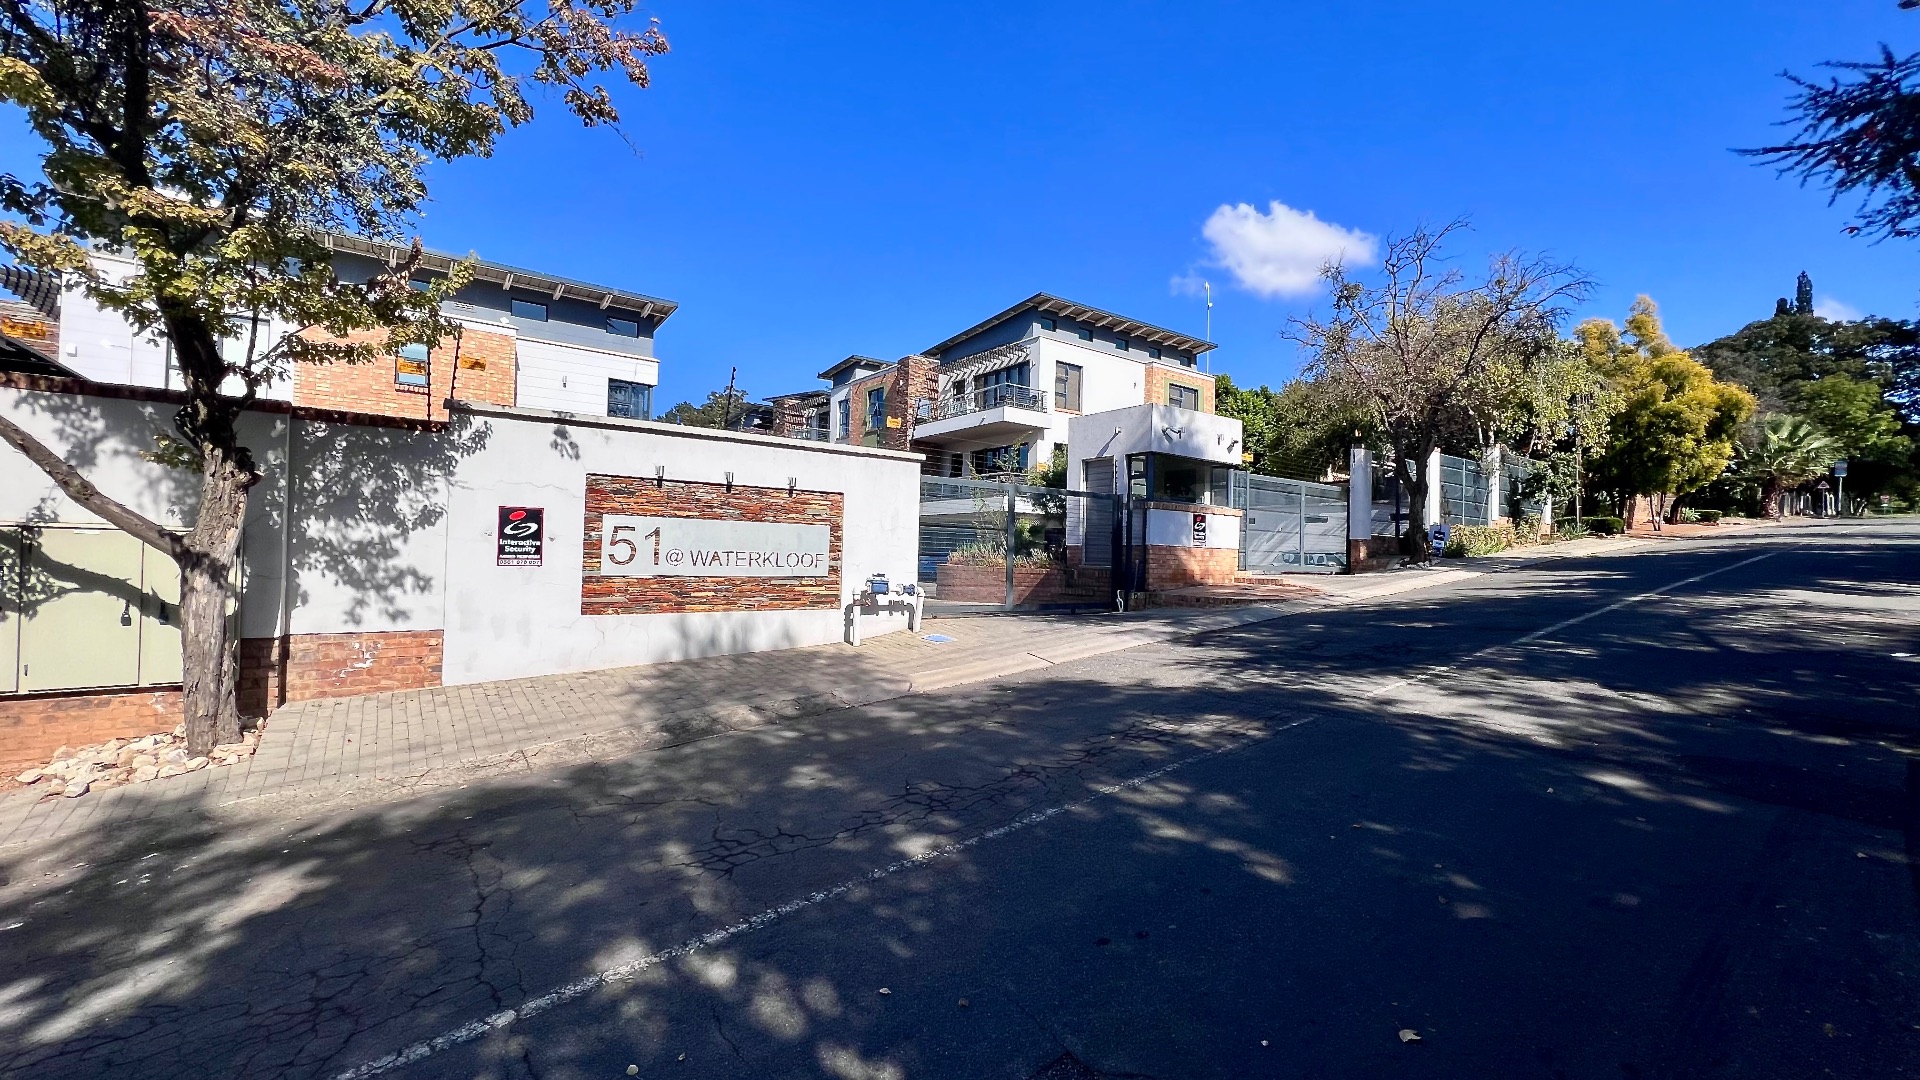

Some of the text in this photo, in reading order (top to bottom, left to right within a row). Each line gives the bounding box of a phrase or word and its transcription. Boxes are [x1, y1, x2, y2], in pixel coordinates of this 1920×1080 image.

[504, 546, 536, 554] Security
[608, 525, 825, 569] 51 @ WATERKLOOF
